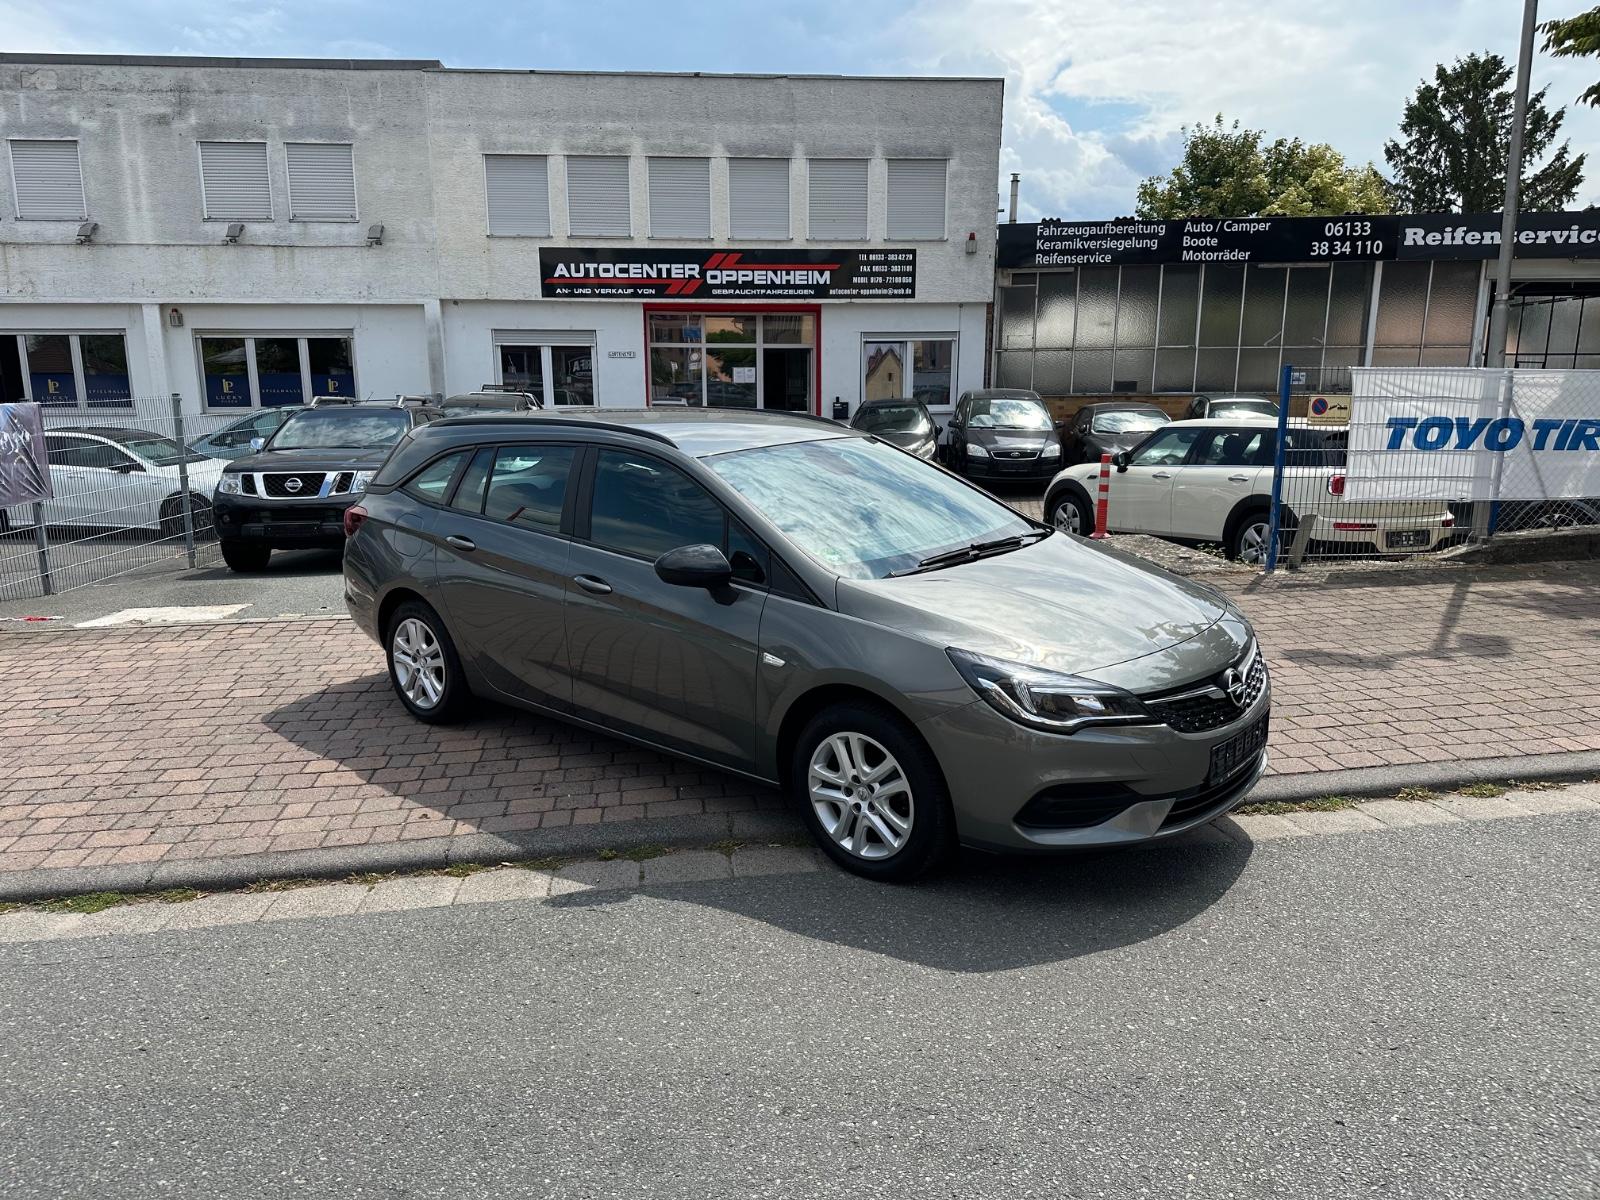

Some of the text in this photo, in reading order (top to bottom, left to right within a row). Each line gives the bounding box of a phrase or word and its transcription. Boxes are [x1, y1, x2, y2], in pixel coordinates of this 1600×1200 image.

[1036, 222, 1166, 237] Fahrzeugaufbereitung
[1184, 221, 1213, 233] Auto
[1223, 220, 1271, 234] Camper
[1324, 222, 1371, 237] 06133
[1182, 236, 1218, 247] Boote
[1403, 225, 1600, 246] Reifenervic
[1036, 237, 1158, 251] Keramikversiegelung
[1310, 240, 1383, 256] 38 34 110
[1035, 252, 1112, 264] Reifenservice
[1181, 249, 1251, 261] Motorräder
[553, 263, 700, 278] AUTOCENTER
[706, 270, 831, 285] OPPENHEIM
[1384, 416, 1525, 452] TOYO
